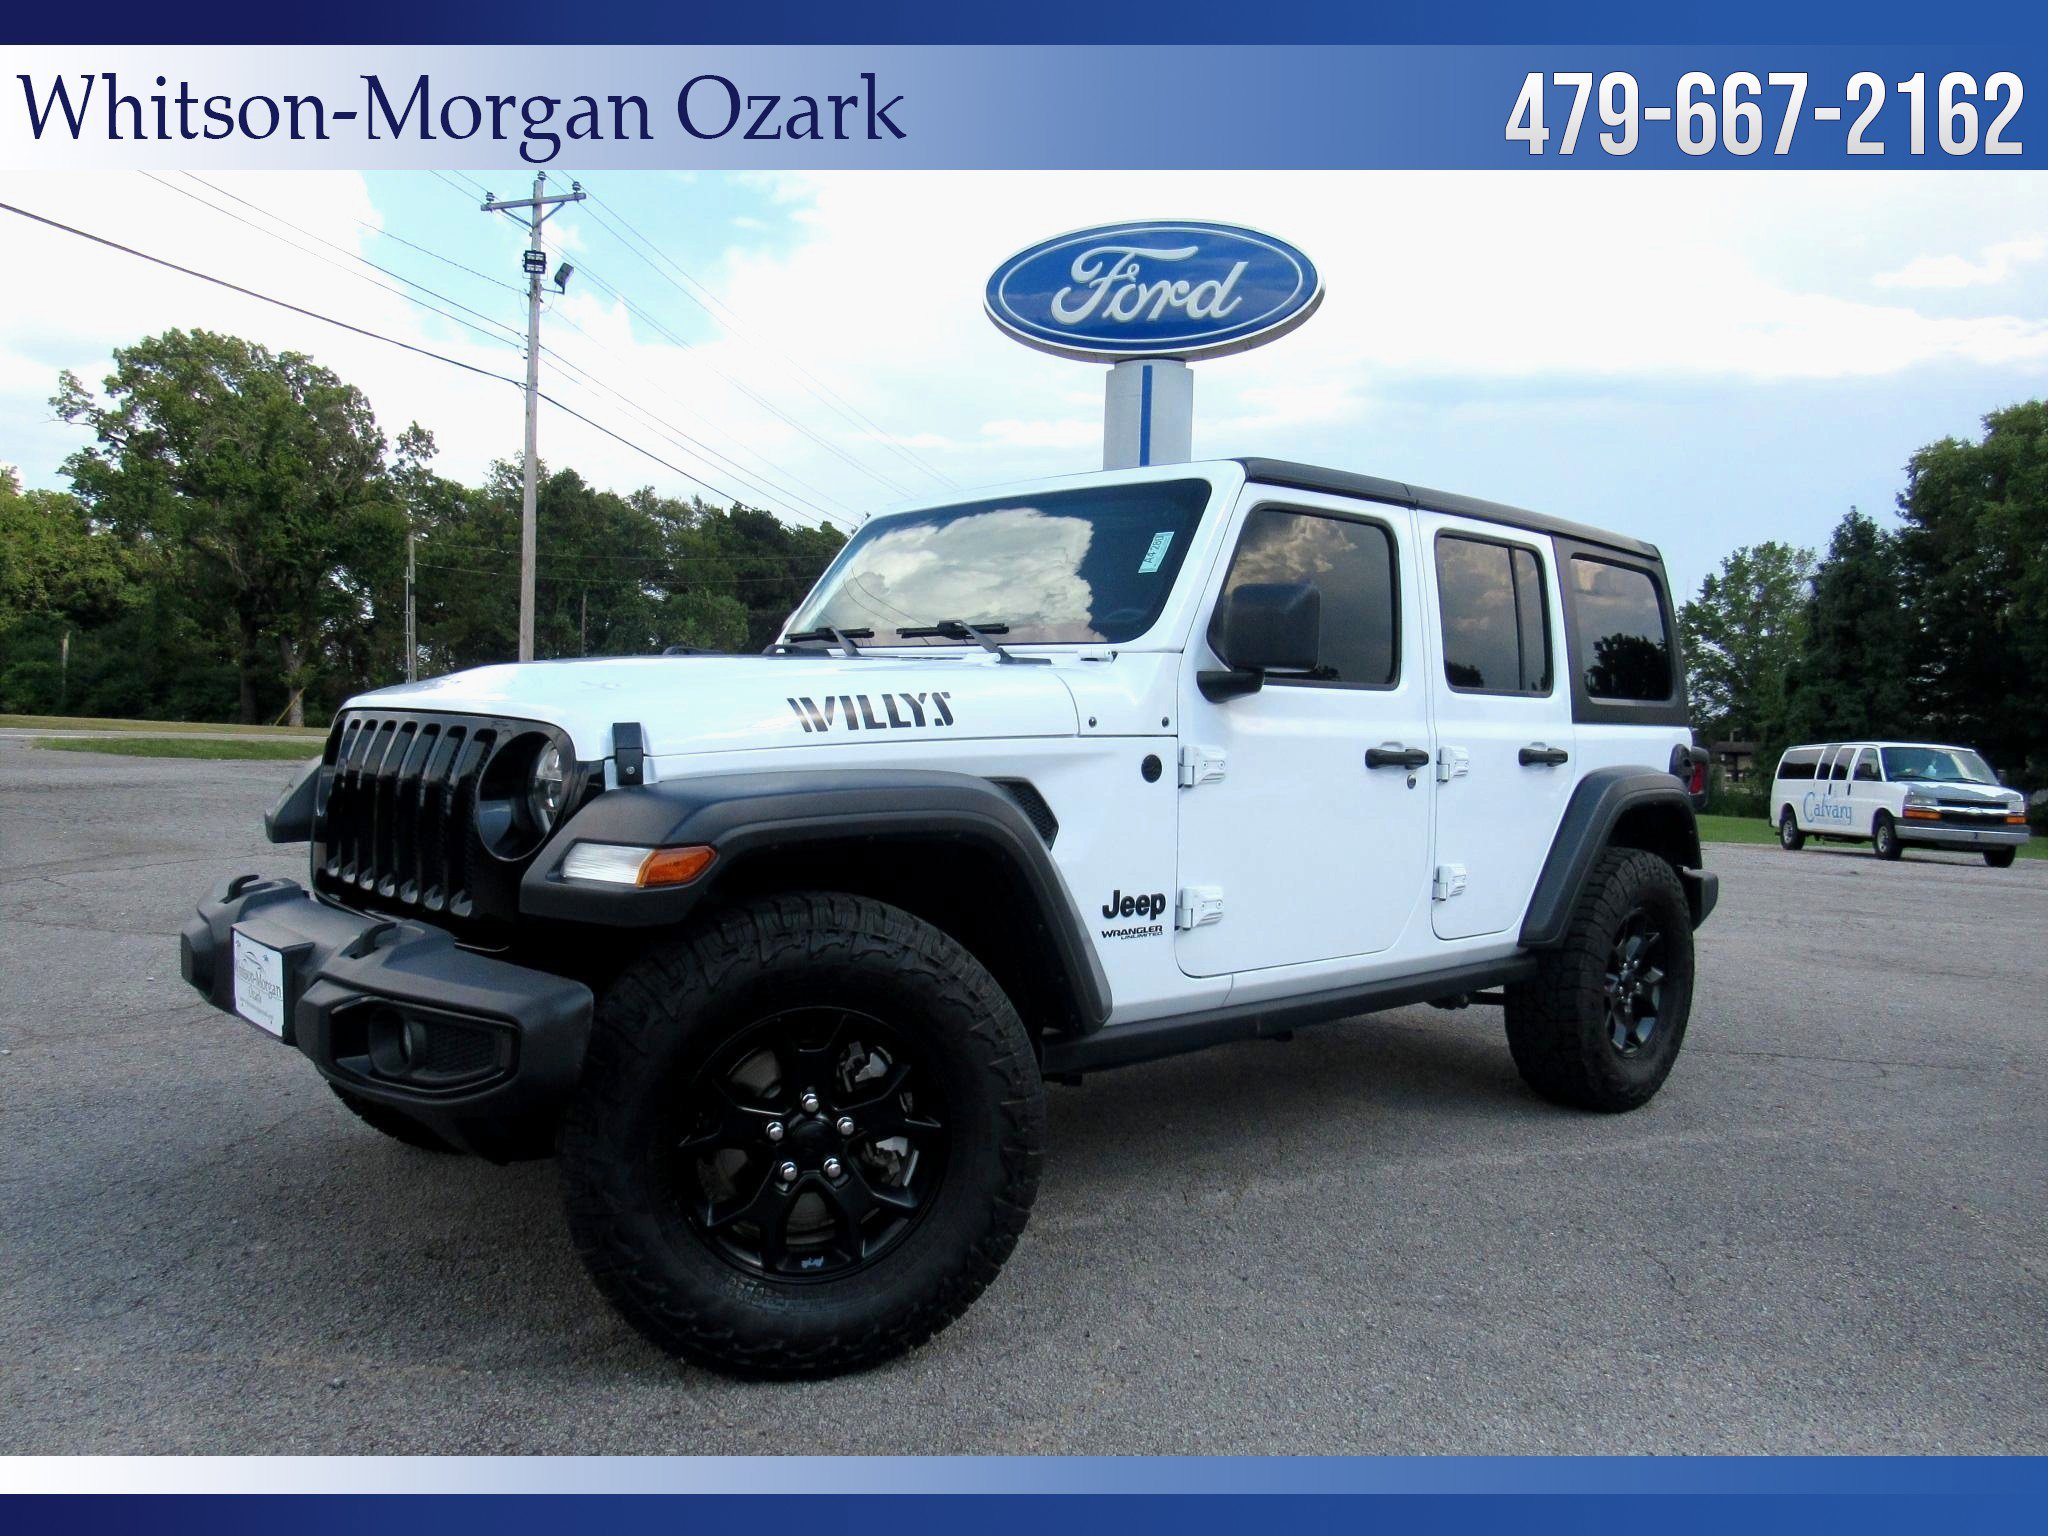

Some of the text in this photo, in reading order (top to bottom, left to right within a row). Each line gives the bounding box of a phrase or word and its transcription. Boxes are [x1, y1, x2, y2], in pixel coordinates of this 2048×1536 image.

[1051, 245, 1248, 325] Ford
[787, 692, 954, 733] WILLYS
[1102, 889, 1166, 921] Jeep
[1101, 925, 1163, 939] WRANGLER
